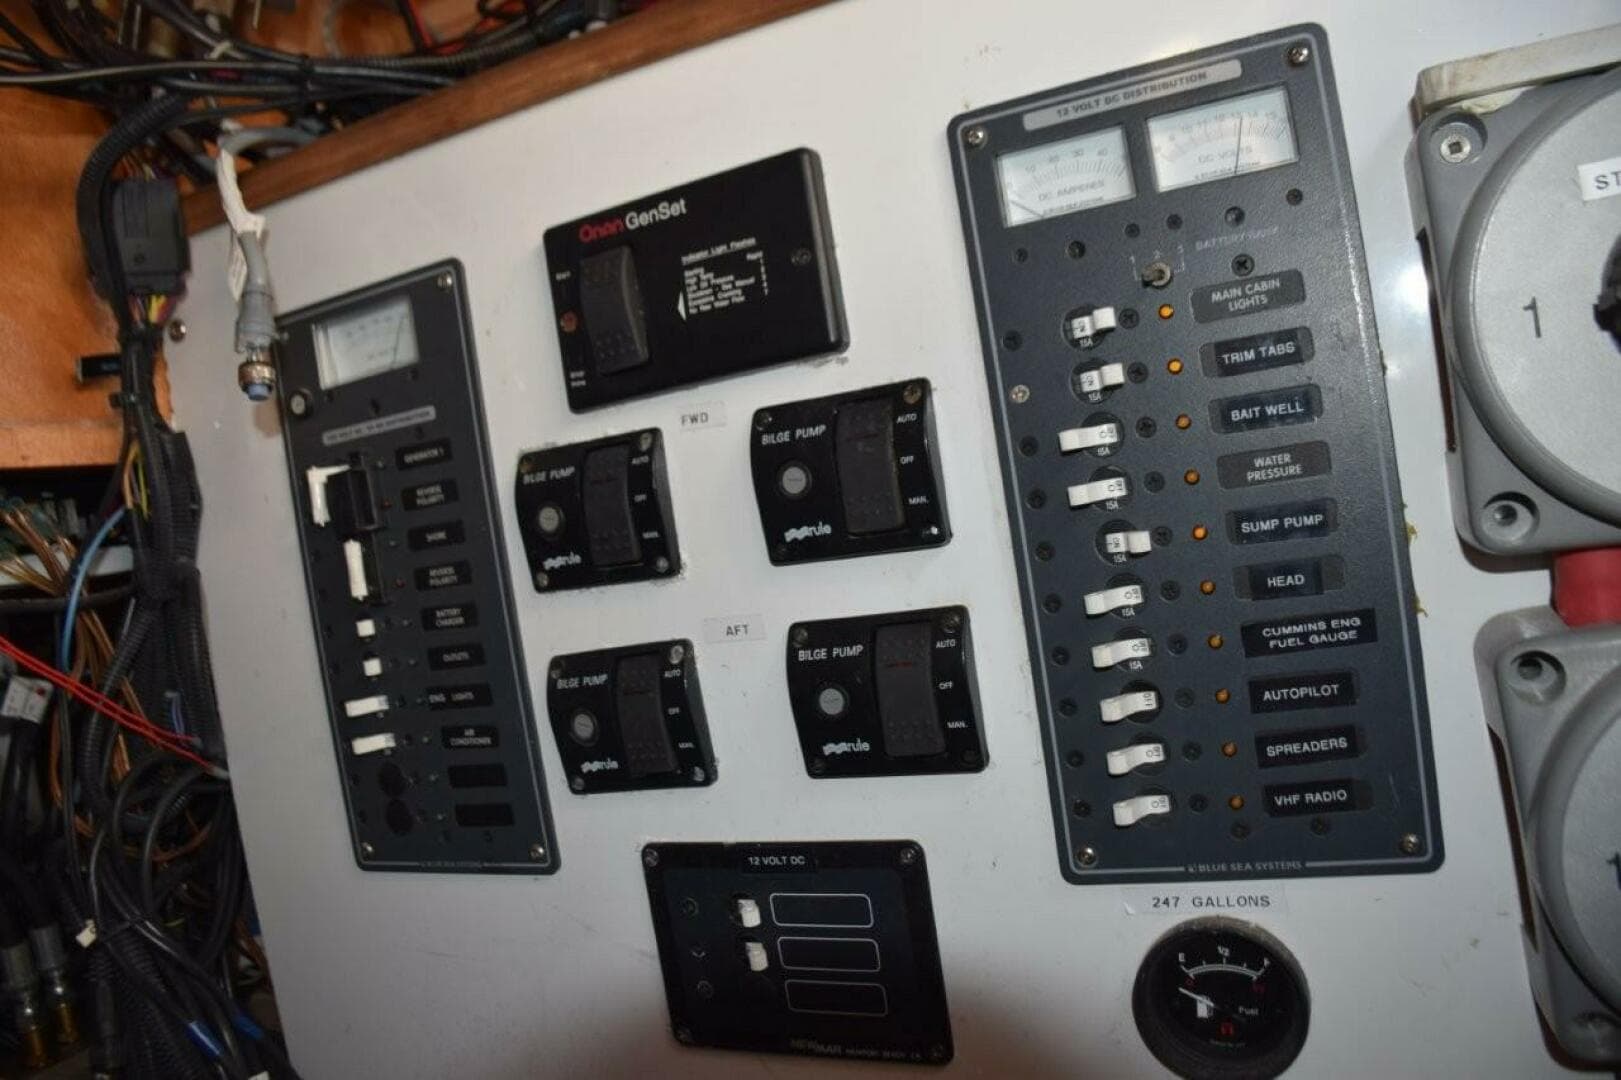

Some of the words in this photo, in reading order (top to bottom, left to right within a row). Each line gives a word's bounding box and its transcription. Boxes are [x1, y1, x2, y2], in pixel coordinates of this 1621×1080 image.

[1056, 108, 1069, 120] 12
[1073, 100, 1101, 115] VOLT
[1105, 95, 1121, 107] DC
[1122, 71, 1208, 103] DISTRIBUTION
[625, 198, 687, 230] GenSet
[1211, 286, 1242, 303] MAIN
[1245, 278, 1280, 294] CABIN
[1228, 294, 1268, 312] LIGHTS
[1523, 296, 1541, 339] 1
[1222, 350, 1256, 365] TRIM
[1259, 341, 1296, 357] TABS
[680, 412, 709, 426] FWD
[897, 413, 918, 424] AUTO
[1231, 407, 1260, 422] BAIT
[1265, 401, 1304, 416] WELL
[761, 431, 790, 446] BILGE
[796, 424, 826, 439] PUMP
[900, 456, 915, 465] OFF
[1254, 453, 1291, 468] WATER
[550, 466, 575, 481] PUMP
[1247, 464, 1303, 481] PRESSURE
[1241, 519, 1280, 534] SUMP
[1284, 514, 1324, 530] PUMP
[1267, 574, 1305, 588] HEAD
[725, 624, 750, 637] AFT
[1262, 620, 1327, 638] CUMMINS
[1331, 616, 1361, 628] ENG
[936, 639, 956, 649] AUTO
[1269, 634, 1304, 649] FUEL
[1309, 630, 1358, 645] GAUGE
[798, 647, 828, 662] BILGE
[832, 644, 864, 659] PUMP
[583, 673, 608, 687] PUMP
[939, 681, 953, 691] OFF
[1263, 684, 1340, 702] AUTOPILOT
[1267, 737, 1348, 757] SPREADERS
[1274, 794, 1301, 807] VHF
[1305, 790, 1348, 804] RADIO
[749, 856, 760, 866] 12
[762, 856, 787, 866] VOLT
[791, 856, 805, 866] DC
[1198, 863, 1228, 873] BLUE
[1230, 862, 1252, 872] SEA
[1255, 861, 1302, 871] SYSTEMS
[1152, 896, 1180, 909] 247
[1192, 895, 1271, 909] GALLONS
